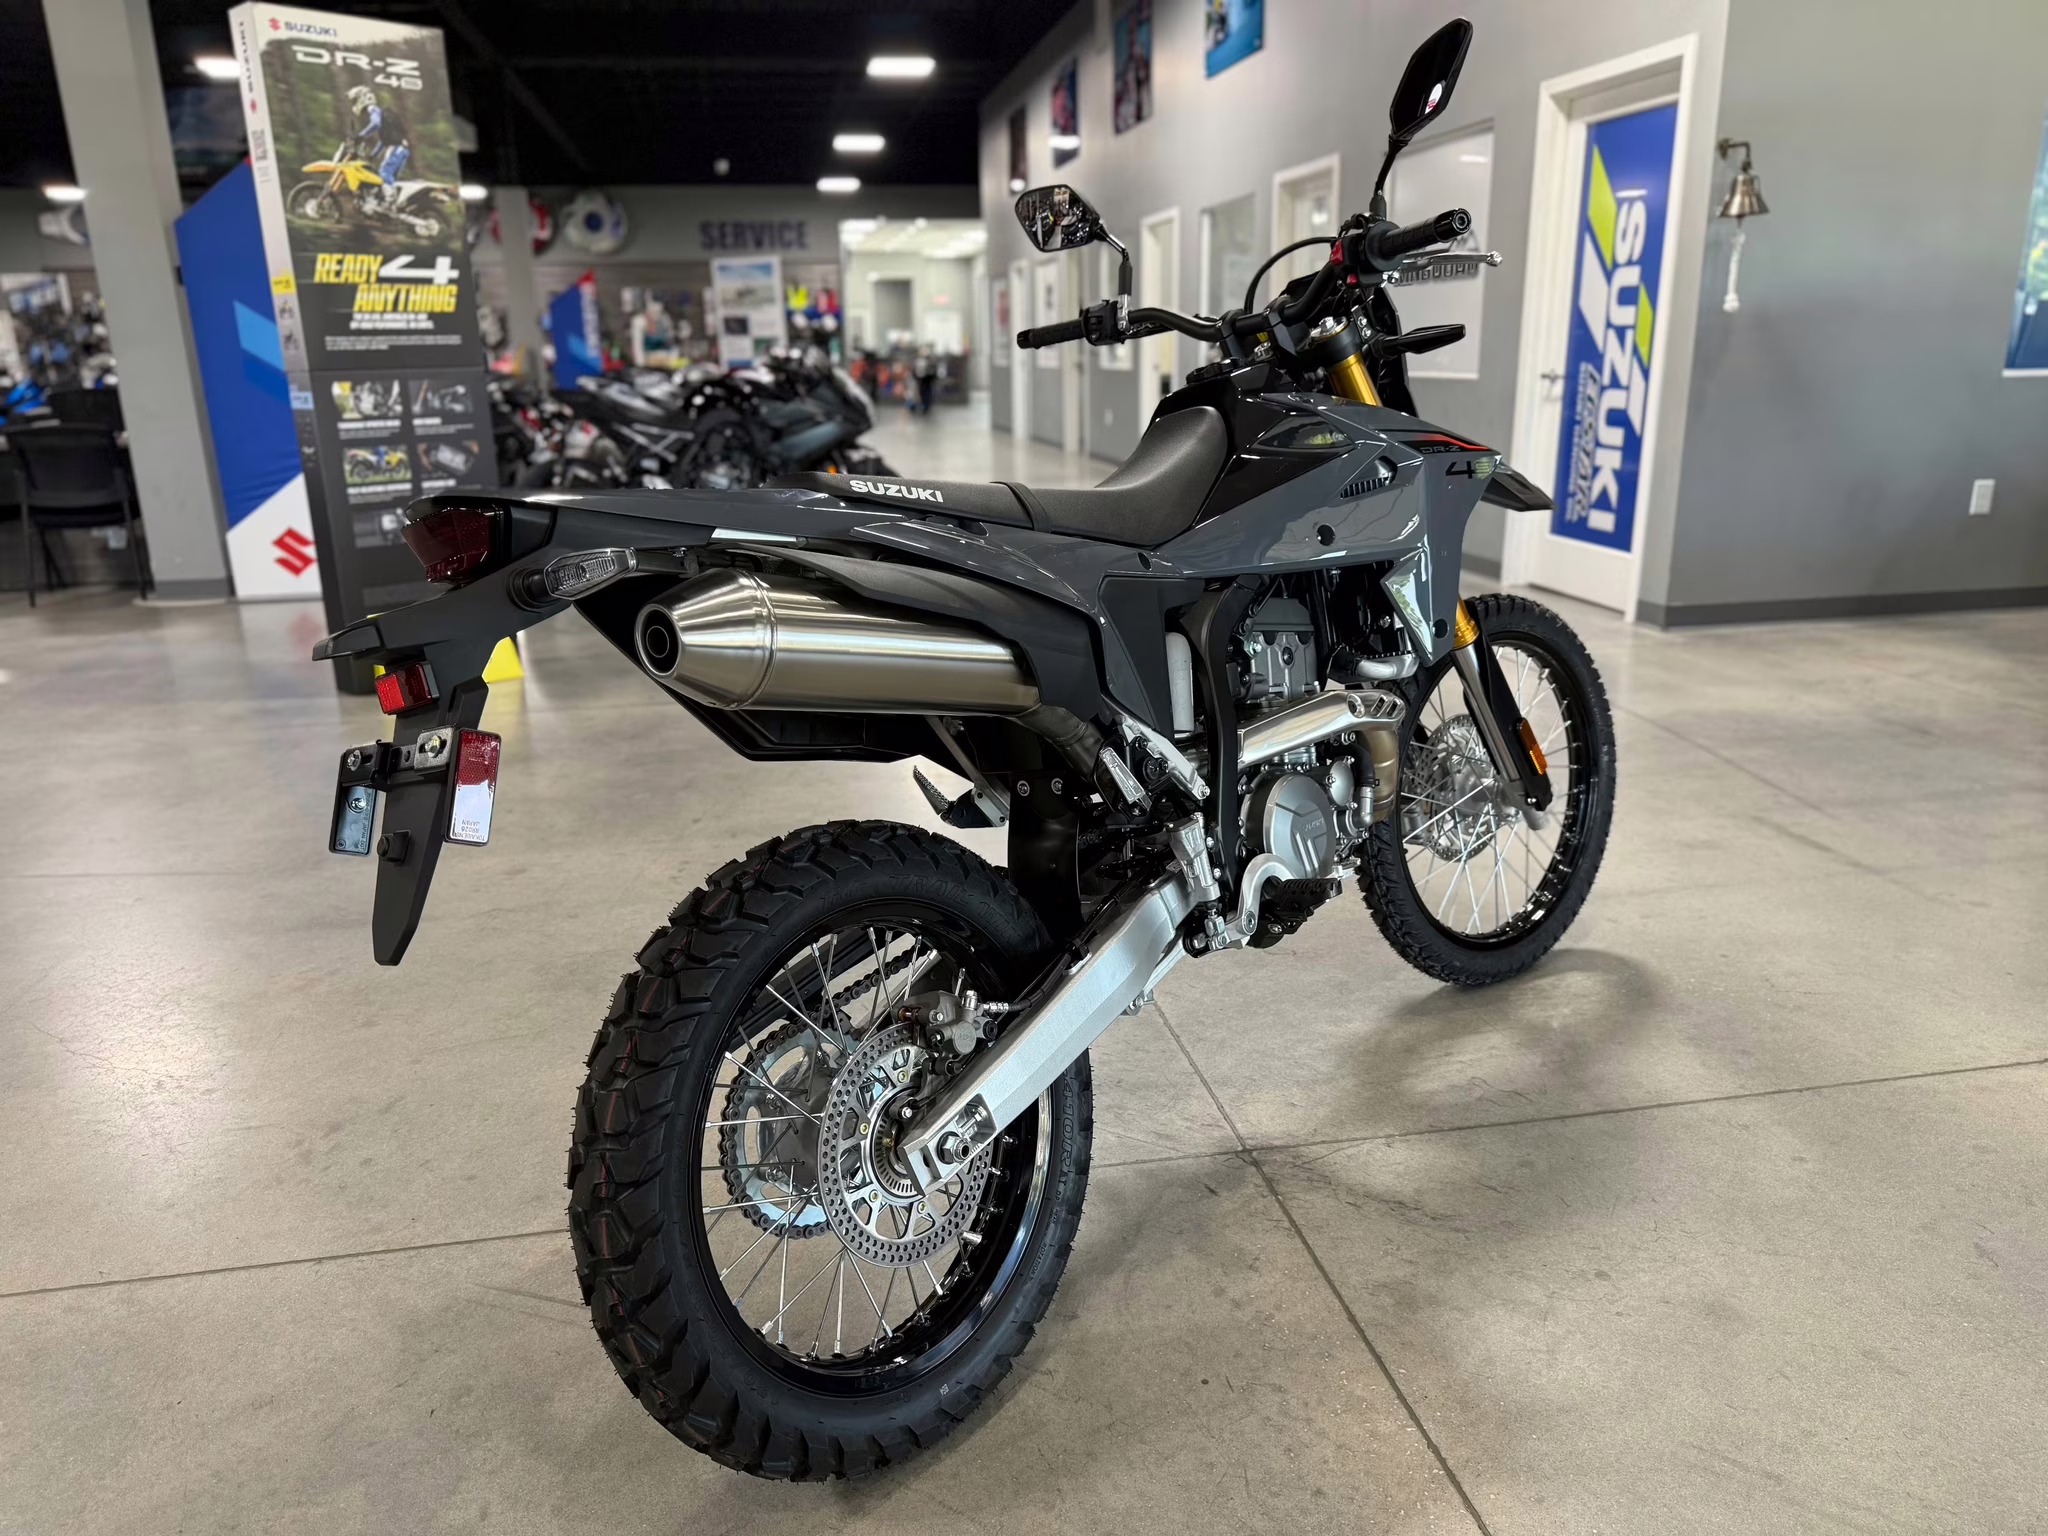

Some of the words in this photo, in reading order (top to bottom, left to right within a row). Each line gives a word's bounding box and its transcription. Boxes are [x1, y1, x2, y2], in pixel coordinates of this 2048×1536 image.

[284, 21, 338, 37] SUZUKI
[291, 45, 421, 77] DR-Z
[700, 220, 808, 250] SERVICE
[314, 254, 384, 284] READY
[379, 254, 460, 285] 4
[353, 284, 459, 313] ANYTHING
[1587, 200, 1647, 533] SUZUKI
[849, 480, 944, 503] SUZUKI
[889, 873, 975, 906] TRAIL
